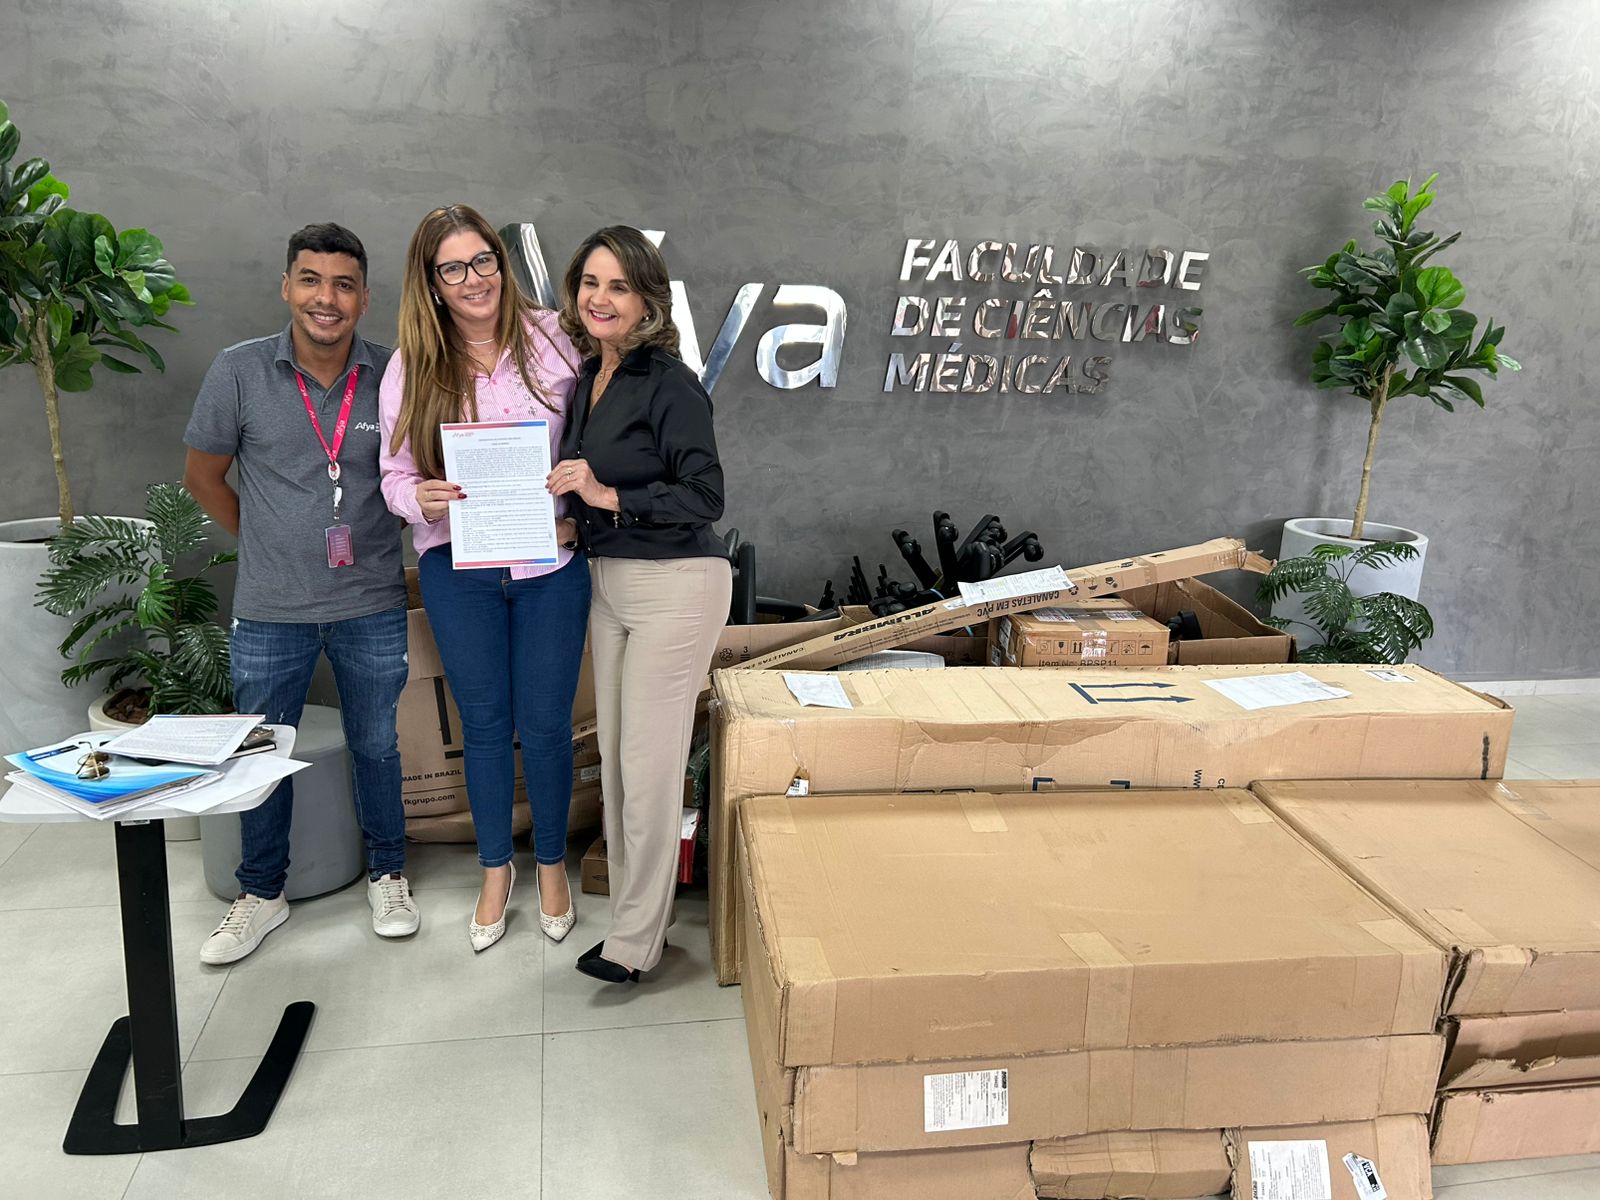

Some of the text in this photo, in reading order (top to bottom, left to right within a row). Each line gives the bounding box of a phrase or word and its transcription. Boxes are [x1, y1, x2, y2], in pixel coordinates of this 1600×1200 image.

[900, 239, 1210, 290] FACULDADE
[497, 222, 848, 396] ya
[891, 288, 1204, 345] DE CIÊNCIAS
[883, 342, 1113, 395] MÉDICAS
[355, 422, 374, 431] Afya
[977, 590, 1060, 616] CANALETAS EM PVC
[834, 606, 936, 642] ALUMBRA
[1038, 659, 1059, 667] Item
[401, 774, 423, 782] MADE
[434, 769, 462, 778] BRAZIL
